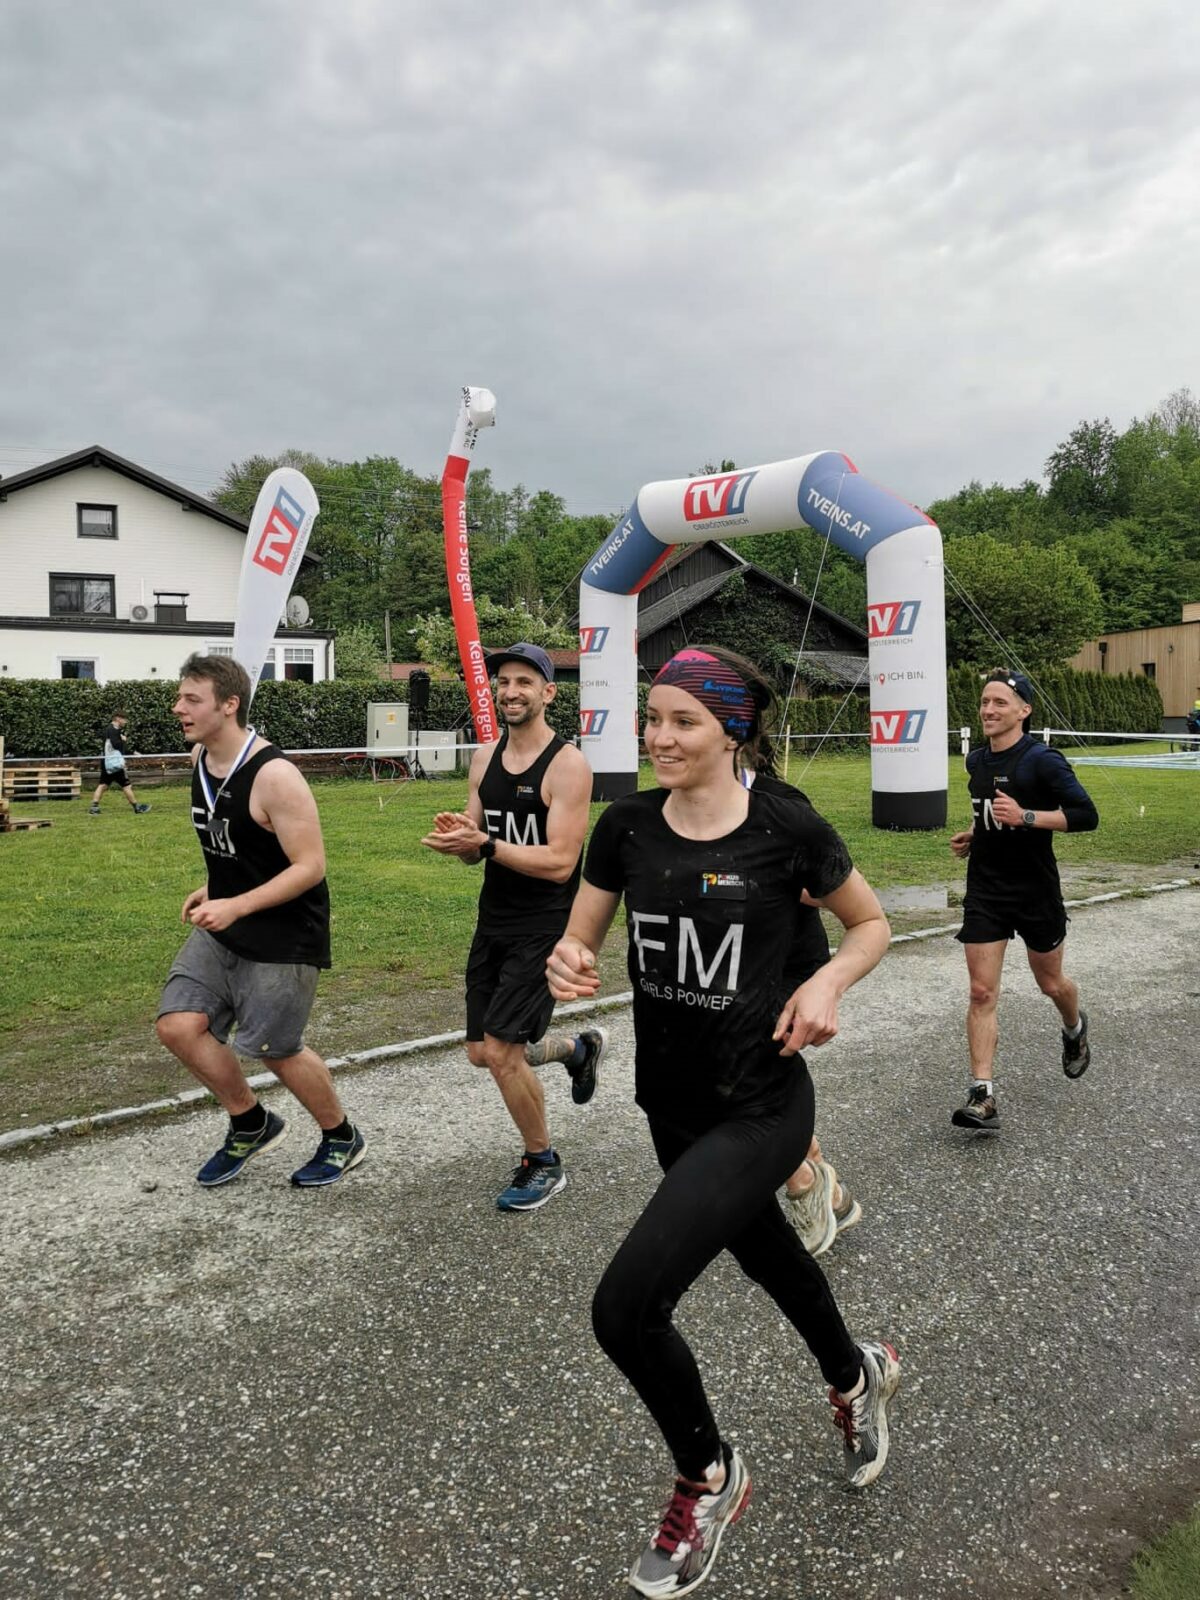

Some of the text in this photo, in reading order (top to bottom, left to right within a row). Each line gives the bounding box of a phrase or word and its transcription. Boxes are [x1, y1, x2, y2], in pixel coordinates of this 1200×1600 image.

[689, 475, 752, 515] TV1
[806, 488, 871, 539] TVEINS.AT
[258, 495, 301, 564] TV1
[590, 518, 634, 575] TVEINS.AT
[468, 640, 494, 743] Keine Sorgen
[887, 671, 904, 681] ICH
[906, 671, 927, 680] BIN.
[484, 809, 540, 846] FM
[632, 910, 745, 991] FM
[640, 977, 674, 1001] GIRLS
